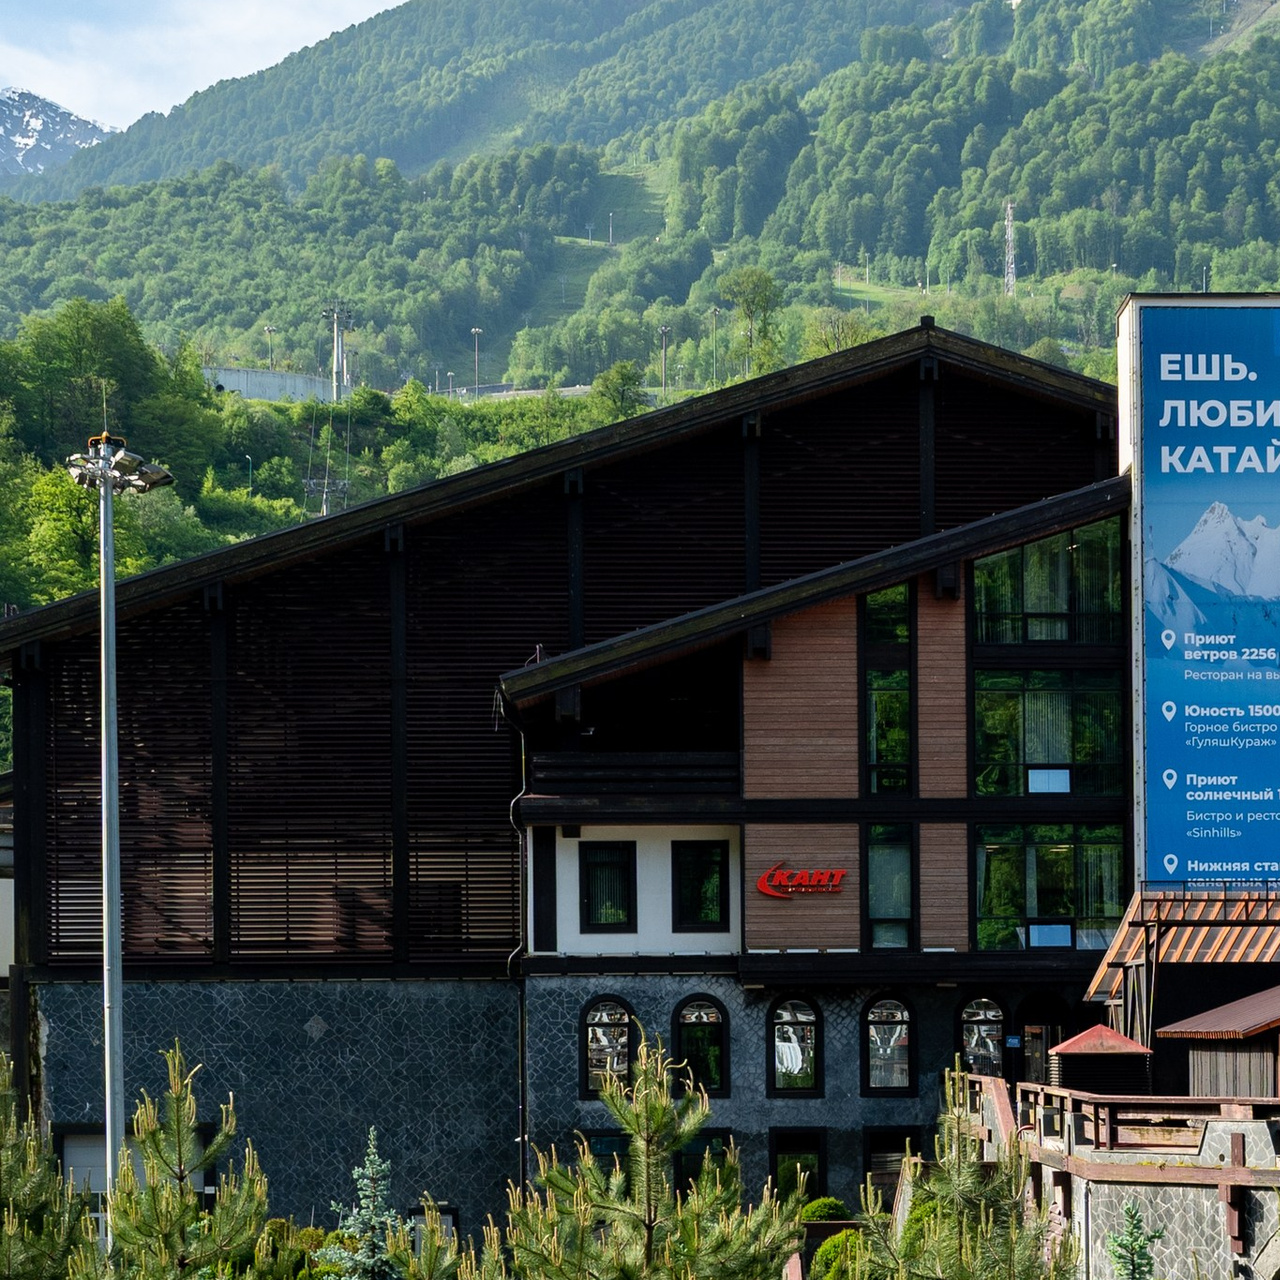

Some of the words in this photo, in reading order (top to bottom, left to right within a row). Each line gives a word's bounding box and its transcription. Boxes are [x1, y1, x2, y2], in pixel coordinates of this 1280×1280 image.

[1160, 353, 1258, 381] ЕШЬ.
[1184, 632, 1236, 647] Приют
[1184, 649, 1238, 662] ветров
[1241, 647, 1277, 660] 2256
[1184, 669, 1243, 682] Ресторан
[1247, 670, 1263, 680] на
[1184, 705, 1245, 717] Юность
[1184, 722, 1229, 734] Горное
[1232, 721, 1278, 734] бистро
[1185, 736, 1277, 749] «ГуляшКураж»
[1186, 773, 1238, 788] Приют
[1186, 787, 1274, 801] солнечный
[1186, 810, 1232, 823] Бистро
[1235, 812, 1244, 821] и
[1186, 826, 1242, 838] «Sinhills»
[1187, 859, 1250, 872] Нижняя
[771, 869, 847, 886] КАНТ
